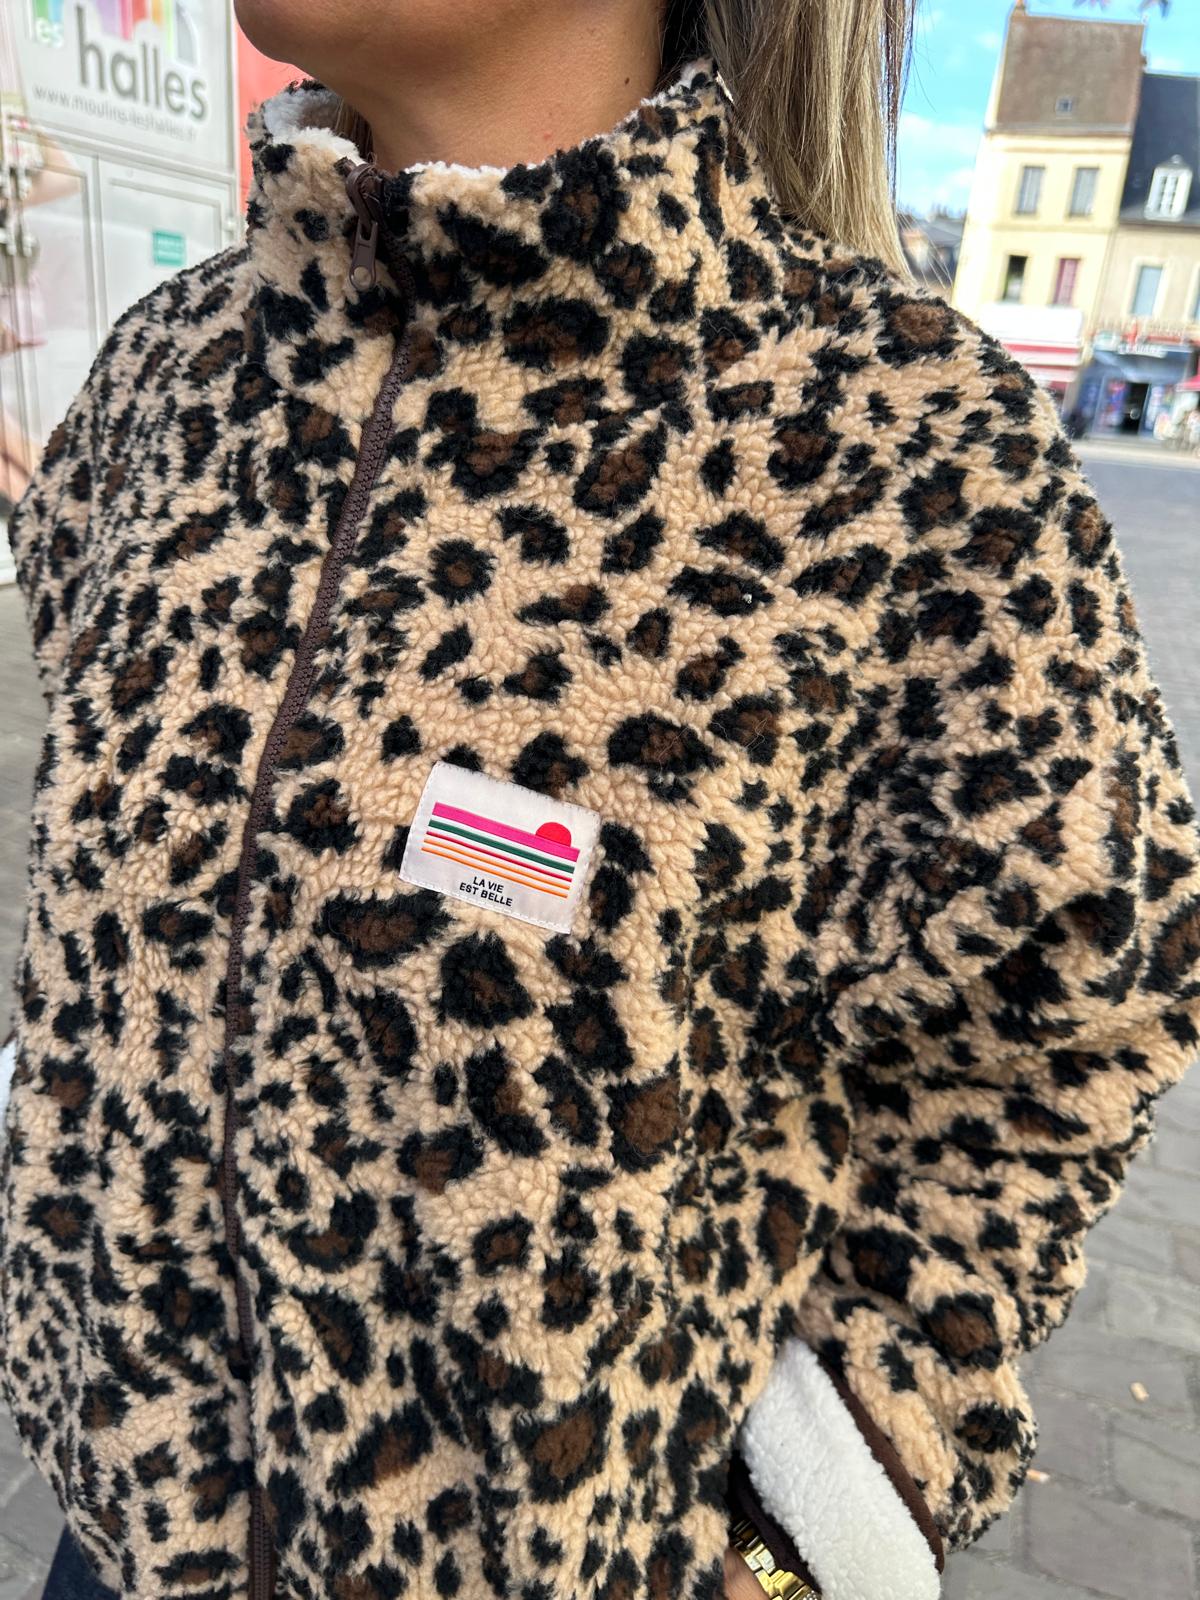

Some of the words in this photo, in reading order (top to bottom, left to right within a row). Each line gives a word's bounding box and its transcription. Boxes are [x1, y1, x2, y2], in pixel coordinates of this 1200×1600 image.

[76, 4, 208, 122] halles
[459, 882, 479, 895] EST
[480, 889, 513, 907] BELLE
[473, 876, 485, 888] LA
[488, 881, 504, 894] VIE
